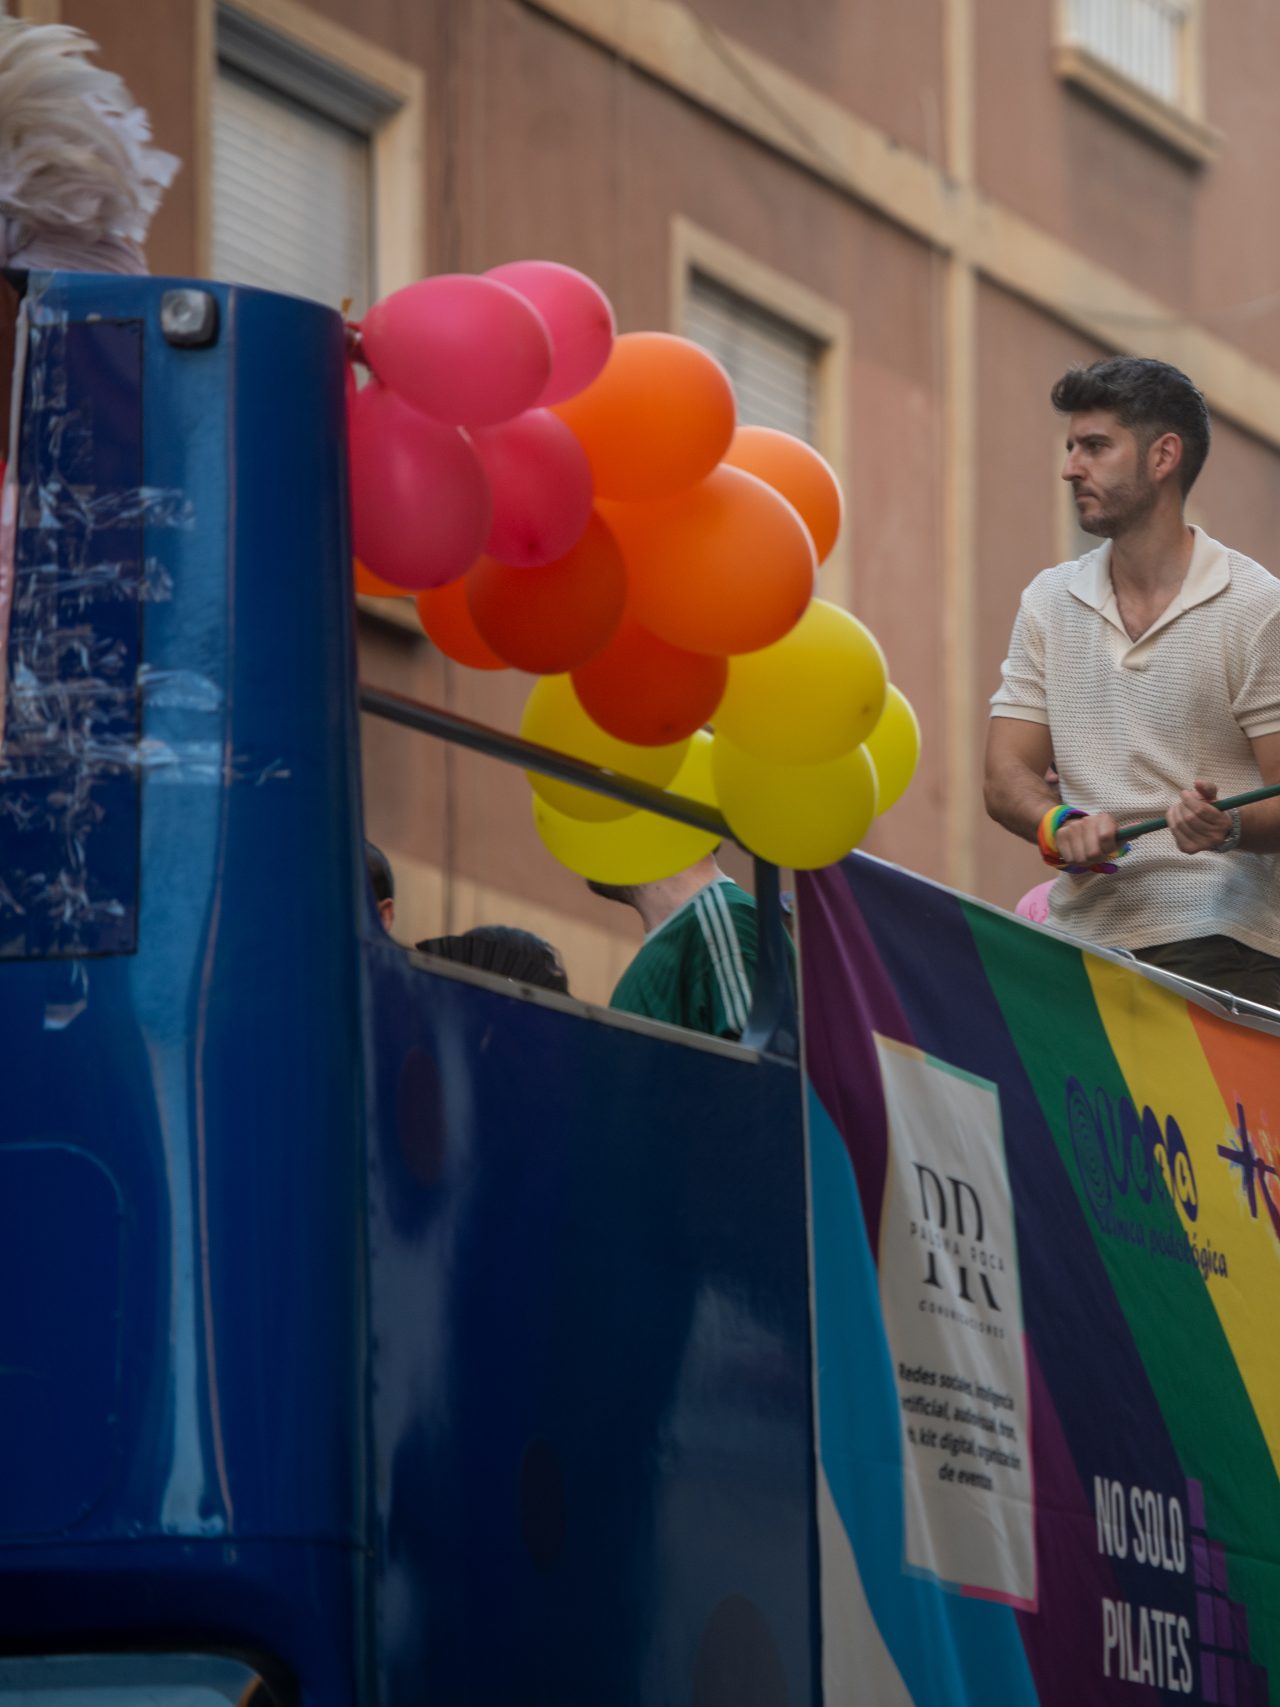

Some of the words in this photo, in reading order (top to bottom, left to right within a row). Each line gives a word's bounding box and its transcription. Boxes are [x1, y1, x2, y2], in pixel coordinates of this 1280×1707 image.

[939, 1462, 955, 1482] de
[1095, 1475, 1126, 1558] NO
[1130, 1482, 1187, 1575] SOLO
[1102, 1597, 1193, 1695] PILATES
